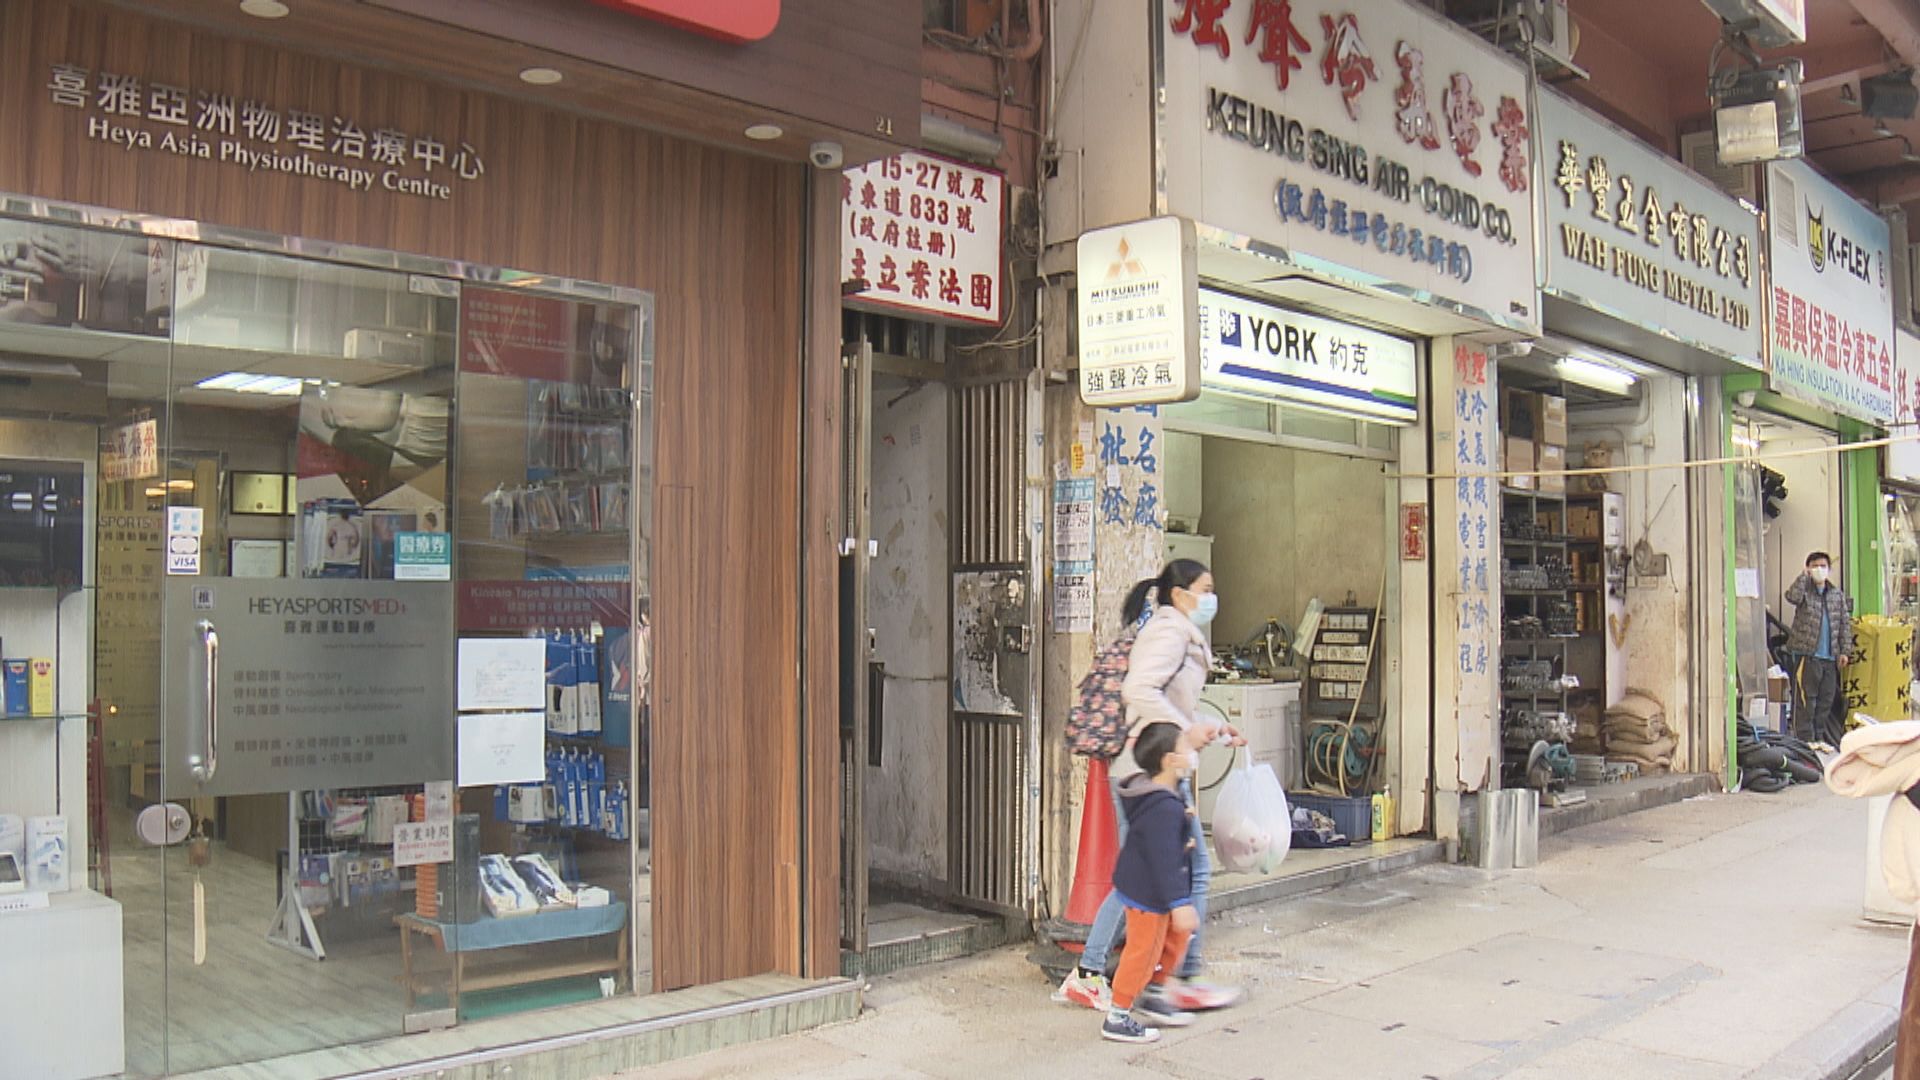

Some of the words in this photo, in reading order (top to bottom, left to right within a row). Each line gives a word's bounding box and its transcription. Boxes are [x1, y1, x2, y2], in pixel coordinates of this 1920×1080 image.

[48, 62, 485, 180] 喜雅亞洲物理治療中心
[876, 116, 893, 135] 21
[88, 117, 151, 150] Heya
[160, 131, 210, 159] Asia
[220, 141, 375, 190] Physiotherapy
[382, 169, 451, 199] Centre
[1207, 87, 1304, 162] KEUNG
[1308, 128, 1368, 185] SING
[1373, 156, 1480, 230] AIR-COND
[1482, 203, 1517, 247] CO.
[850, 210, 956, 259] (政府註冊)
[1555, 138, 1752, 289] 華豐五金有限公司
[1560, 222, 1609, 271] WAH
[1613, 246, 1661, 292] FUNG
[1664, 269, 1720, 318] METAL
[1722, 295, 1750, 331] LTD
[1827, 228, 1871, 285] K-FLEX
[1248, 315, 1318, 365] YORK
[1329, 336, 1368, 376] 約克
[1088, 362, 1172, 393] 強聲冷氣
[1807, 367, 1844, 398] INSULATION
[1099, 404, 1130, 527] 批發
[1133, 404, 1163, 529] 名廠
[174, 557, 197, 567] VISA
